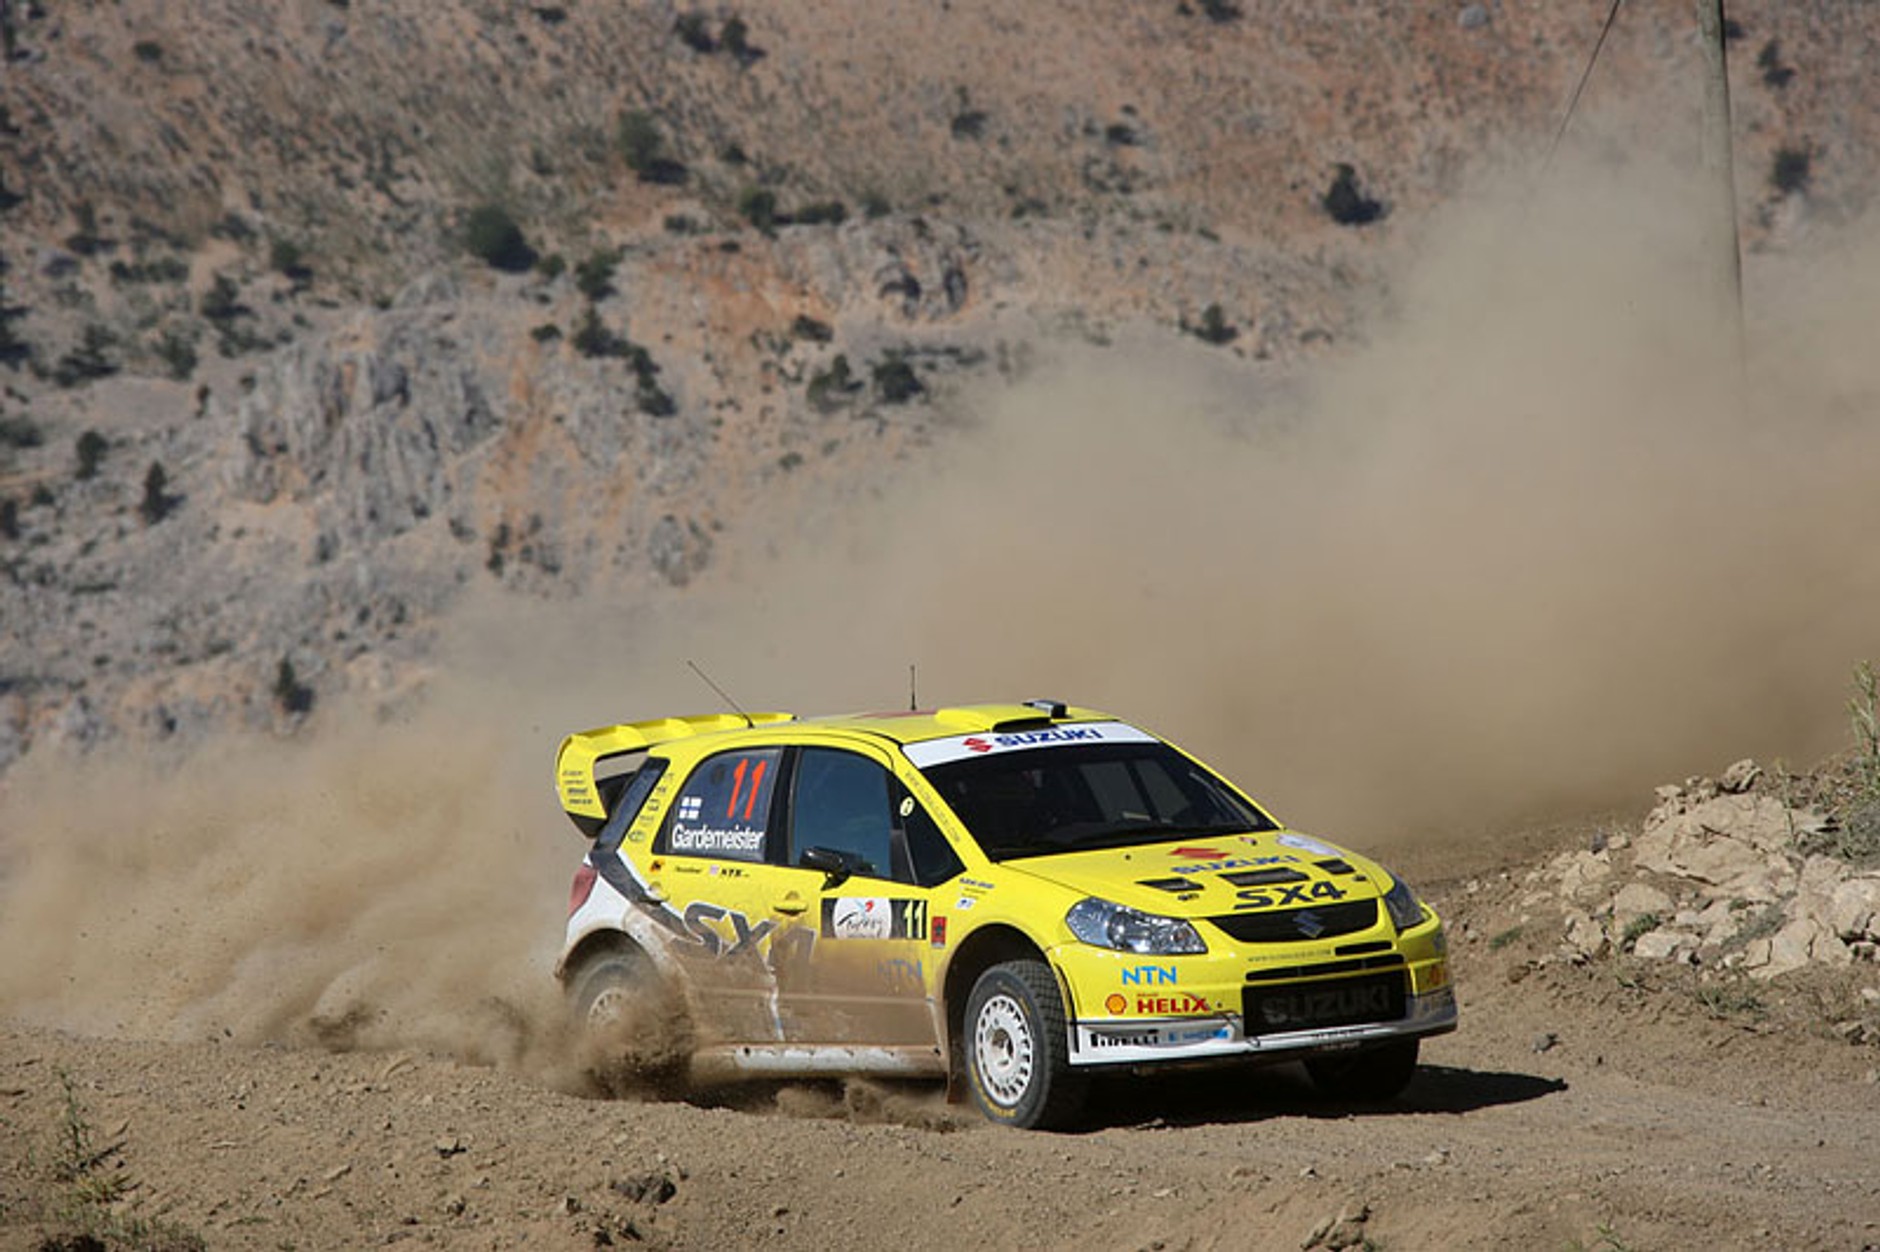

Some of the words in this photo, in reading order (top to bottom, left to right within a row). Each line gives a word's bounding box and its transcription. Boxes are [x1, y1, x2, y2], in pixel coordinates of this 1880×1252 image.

[994, 728, 1103, 747] SUZUKI
[726, 758, 768, 820] 11
[671, 823, 764, 850] Gardemeister
[1171, 855, 1302, 874] SUZUKI
[1233, 880, 1348, 910] SX4
[903, 899, 925, 939] 11
[1122, 965, 1177, 985] NTN
[1137, 992, 1210, 1014] HELIX
[1262, 984, 1391, 1024] SUZUKI
